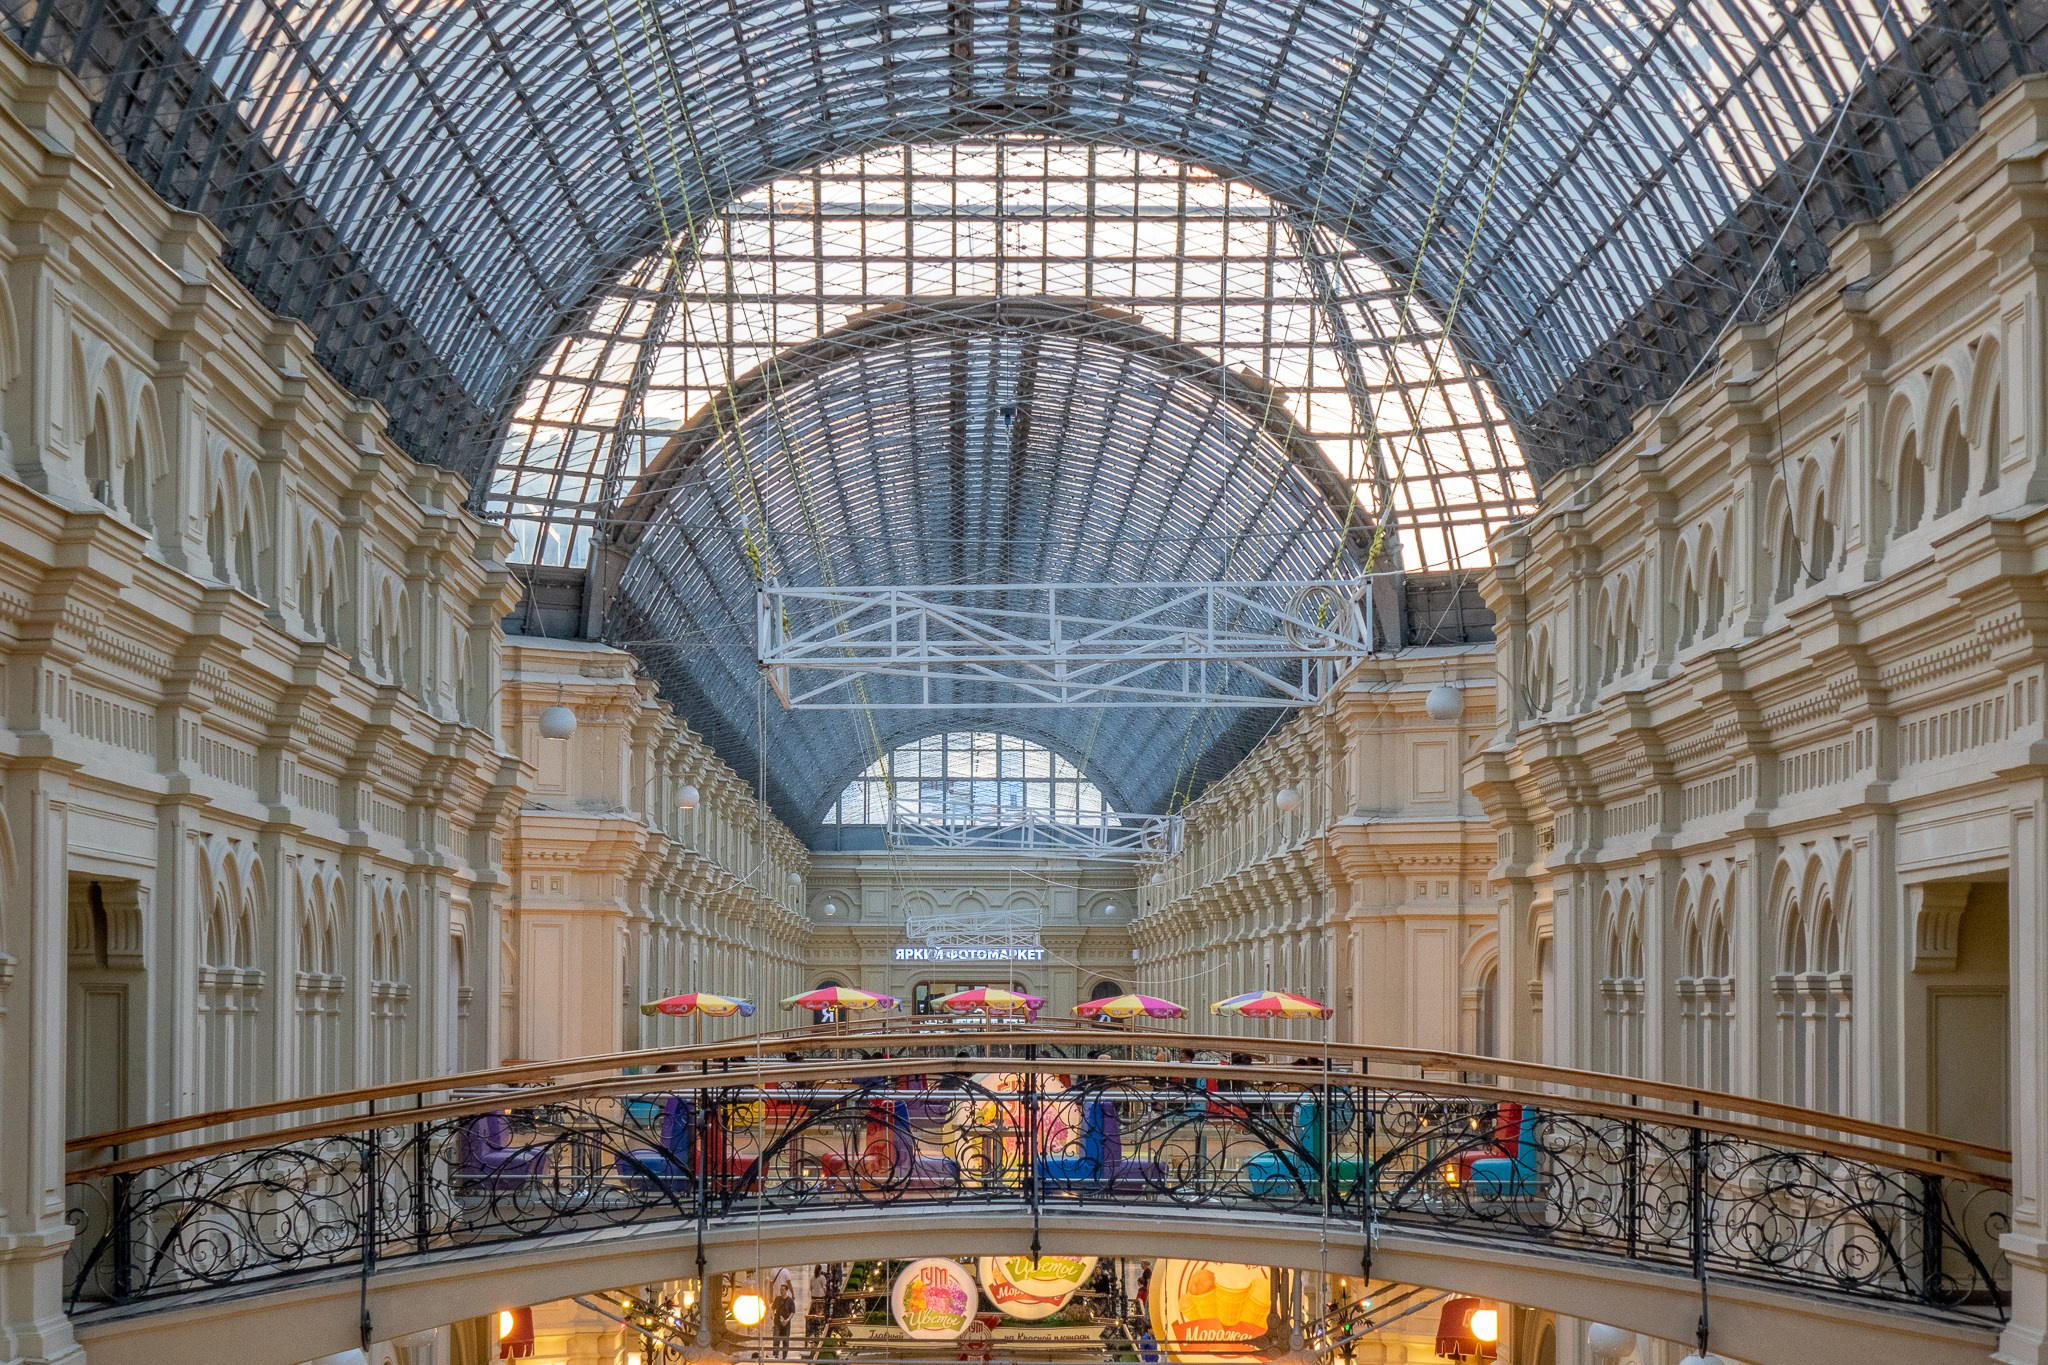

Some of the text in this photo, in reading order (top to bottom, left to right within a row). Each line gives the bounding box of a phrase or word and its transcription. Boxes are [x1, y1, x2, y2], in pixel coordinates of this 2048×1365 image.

[946, 948, 1045, 960] ФОТОМАРКЕТ
[921, 1266, 948, 1286] ГУМ
[907, 1309, 961, 1331] Цветы
[1182, 1325, 1261, 1350] Мороже
